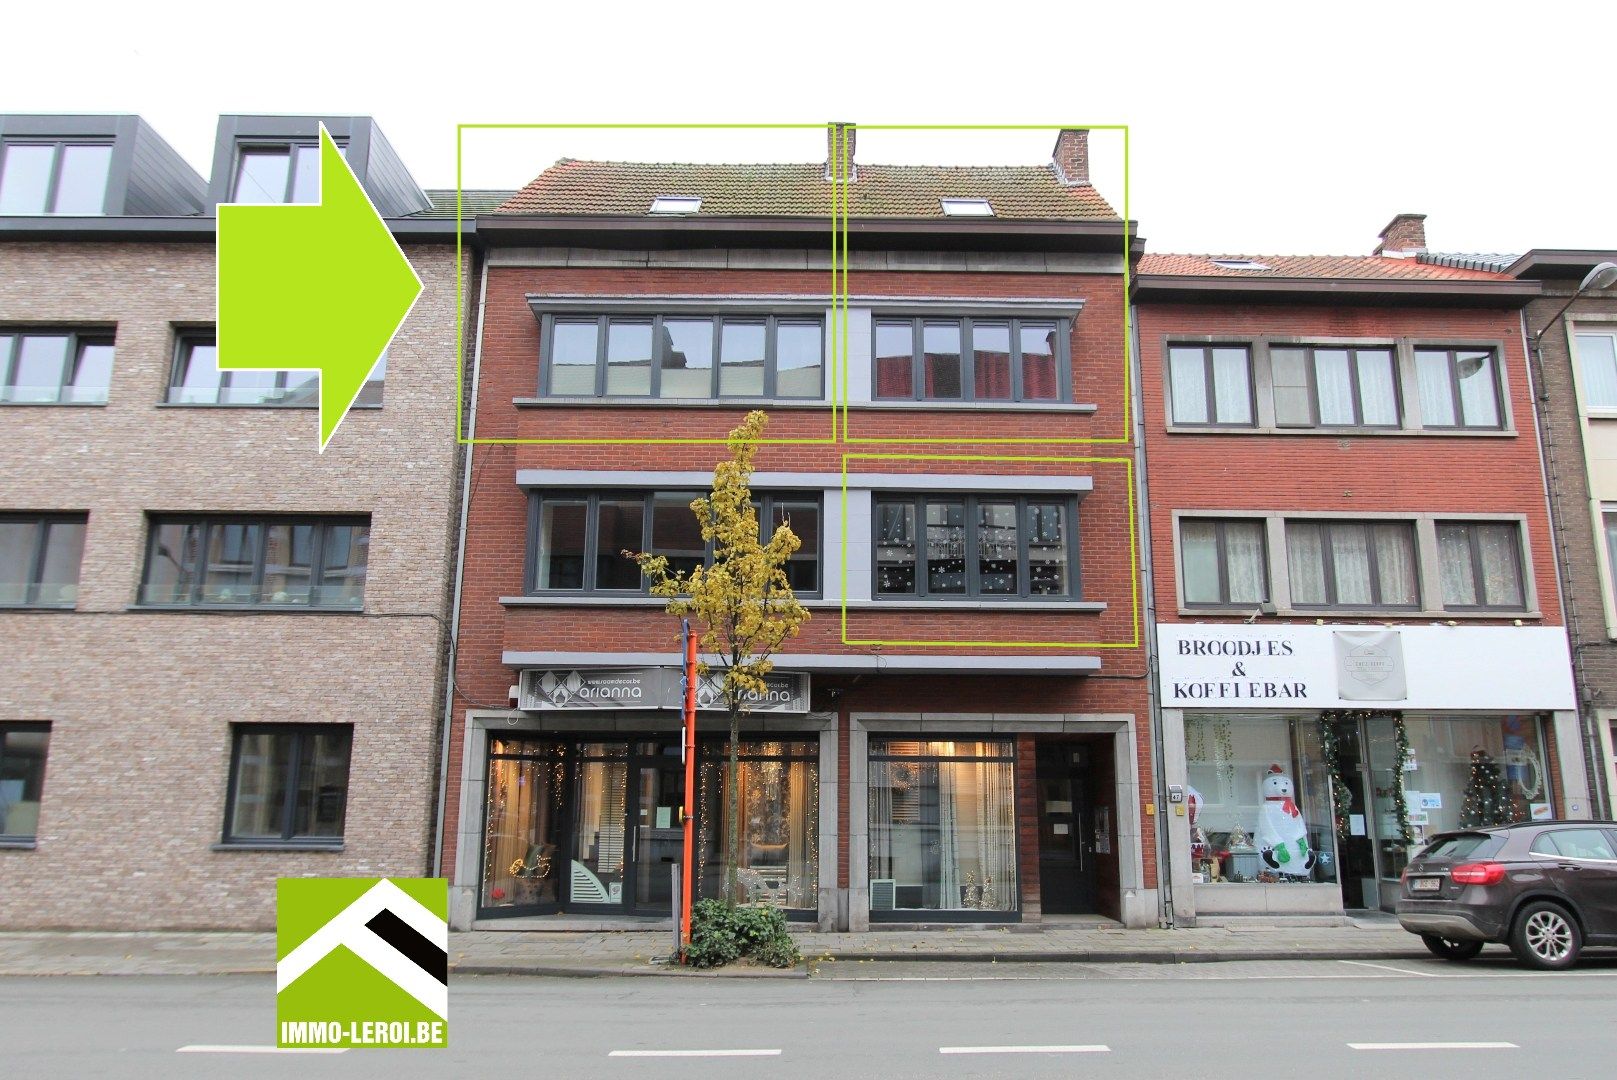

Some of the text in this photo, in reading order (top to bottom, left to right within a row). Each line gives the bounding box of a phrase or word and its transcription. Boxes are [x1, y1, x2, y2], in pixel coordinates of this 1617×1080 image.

[1178, 640, 1294, 656] BROODJES
[1232, 661, 1246, 677] &
[579, 686, 642, 698] arianna
[1173, 682, 1308, 699] KOFFIEBAR
